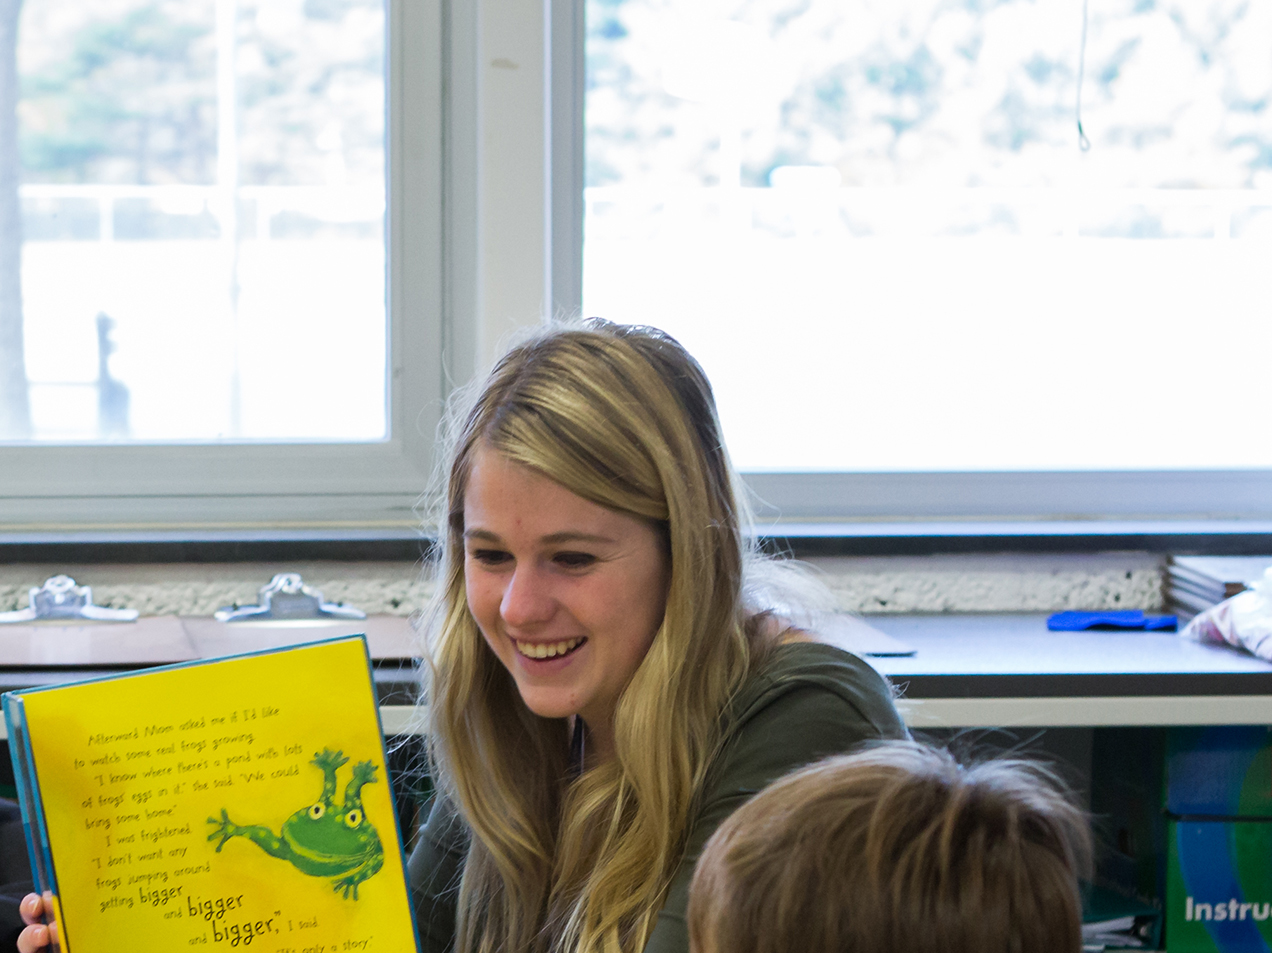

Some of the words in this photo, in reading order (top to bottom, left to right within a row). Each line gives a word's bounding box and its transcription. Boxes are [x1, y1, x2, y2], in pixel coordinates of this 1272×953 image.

[88, 727, 139, 747] Afterward
[144, 724, 174, 738] Mom
[179, 716, 206, 731] asked
[211, 716, 226, 725] me
[230, 711, 238, 723] if
[243, 708, 257, 722] I'd
[262, 706, 280, 719] like
[73, 758, 85, 770] to
[90, 752, 121, 766] watch
[126, 750, 152, 761] some
[156, 742, 175, 755] real
[181, 740, 207, 753] frogs
[109, 773, 137, 784] know
[142, 766, 172, 778] where
[177, 759, 208, 774] there's
[214, 759, 220, 767] a
[226, 750, 251, 770] pond
[256, 747, 279, 760] with
[284, 743, 303, 757] lots
[81, 797, 93, 809] of
[132, 790, 152, 804] eggs
[158, 788, 168, 797] in
[192, 780, 209, 792] she
[239, 770, 265, 783] "We
[271, 764, 300, 779] could
[85, 818, 111, 830] bring
[116, 814, 140, 825] some
[106, 835, 111, 847] I
[116, 834, 135, 844] was
[108, 853, 132, 867] don't
[137, 848, 163, 861] want
[169, 847, 188, 858] any
[96, 877, 122, 891] frogs
[128, 871, 169, 885] jumping
[173, 860, 211, 877] around
[100, 896, 134, 913] getting
[139, 885, 183, 907] bigger
[163, 906, 183, 919] and
[187, 894, 244, 921] bigger
[1185, 896, 1272, 921] Instru
[188, 932, 208, 946] and
[212, 910, 281, 948] bigger,"
[288, 919, 293, 932] I
[330, 944, 338, 952] a
